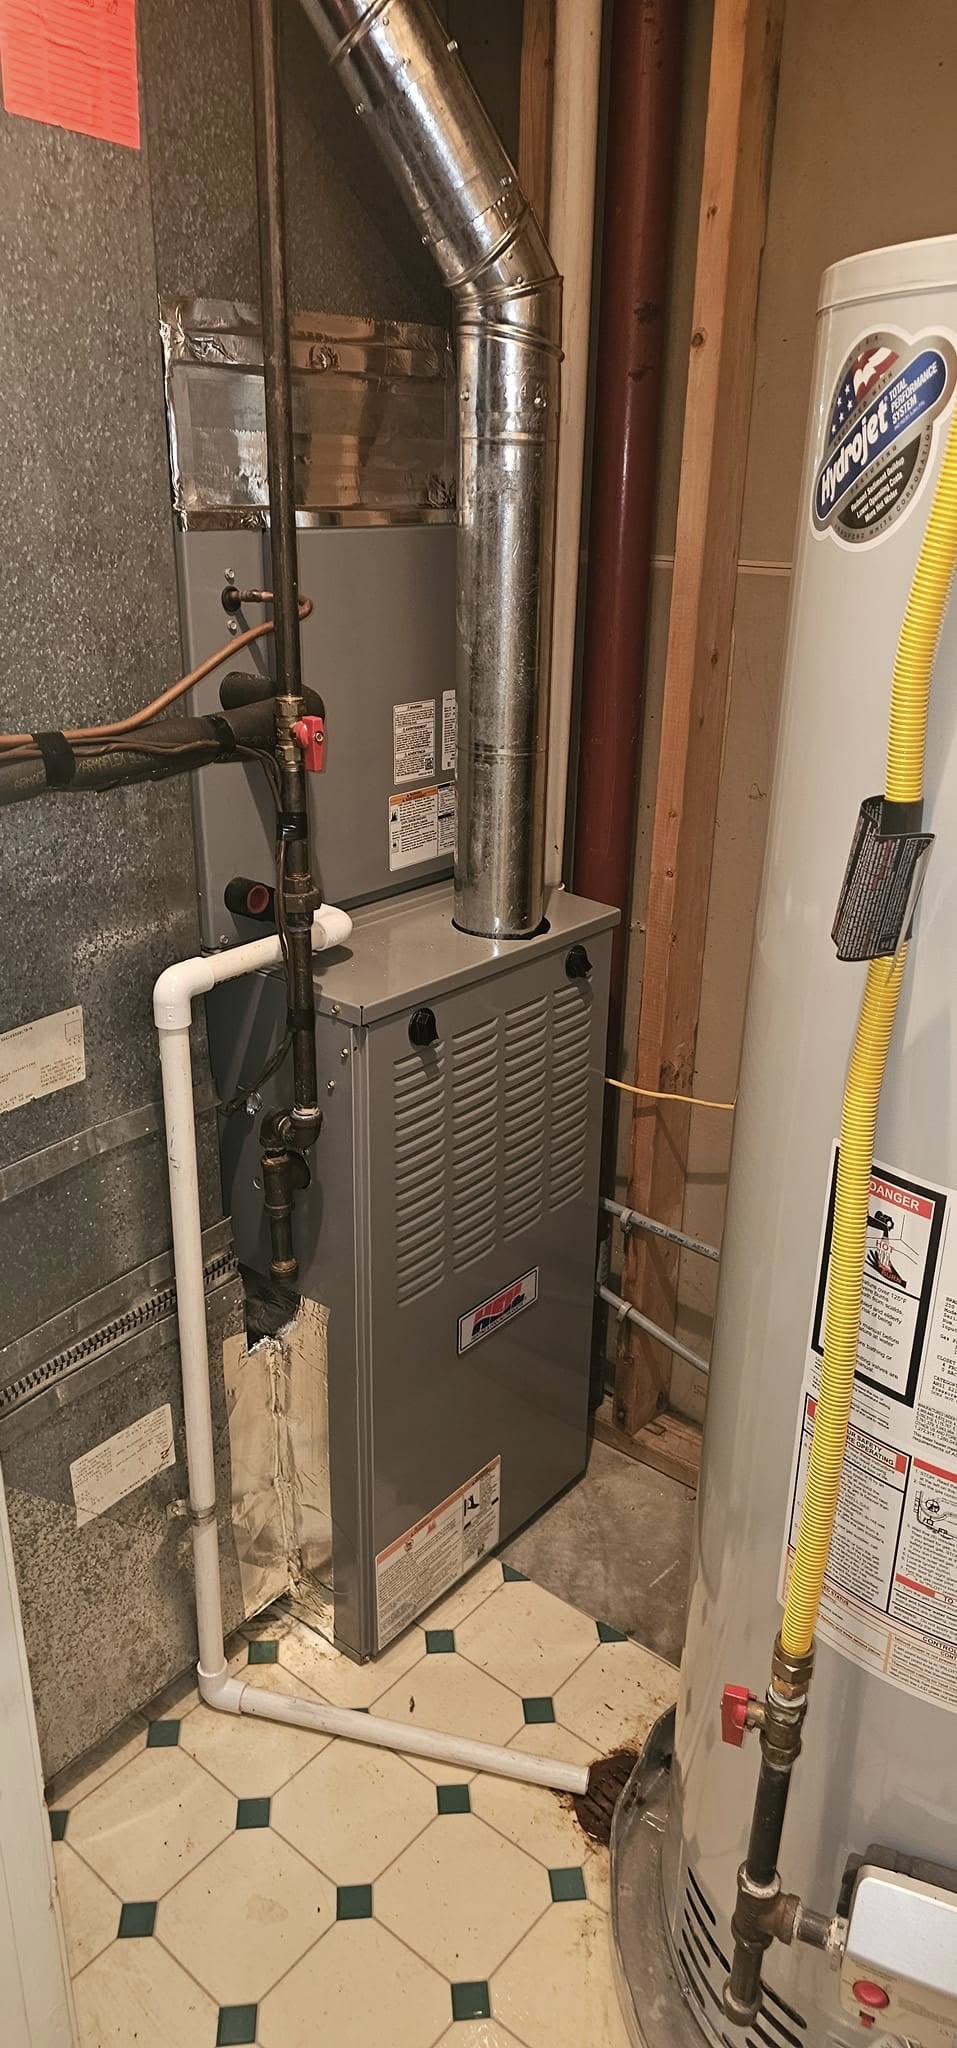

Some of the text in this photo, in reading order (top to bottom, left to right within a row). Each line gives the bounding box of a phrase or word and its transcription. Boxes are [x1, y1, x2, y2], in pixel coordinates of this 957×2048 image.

[889, 378, 908, 401] TOTAL
[891, 361, 938, 413] PERFORMANCE
[892, 394, 917, 425] SYSTEM
[867, 472, 887, 495] Sediment
[886, 457, 905, 476] Buildup
[869, 516, 892, 535] WHITE
[897, 424, 930, 511] CORPORATION
[857, 472, 903, 519] Lower Operating Costs
[865, 489, 898, 522] More Hot Water
[869, 1181, 920, 1211] DANGER
[876, 1239, 894, 1253] HOT
[872, 1294, 884, 1306] from
[877, 1287, 890, 1297] over
[873, 1305, 902, 1325] and elderly
[877, 1315, 892, 1326] being
[862, 1322, 882, 1335] manual
[882, 1331, 900, 1345] before
[879, 1336, 895, 1347] water
[866, 1342, 885, 1358] bathing
[871, 1362, 889, 1374] valves
[933, 1375, 957, 1387] CATEGOR
[856, 1435, 882, 1452] SAFETY
[856, 1441, 894, 1466] OPERATING
[831, 1590, 849, 1606] STATUS
[944, 1595, 954, 1604] TO
